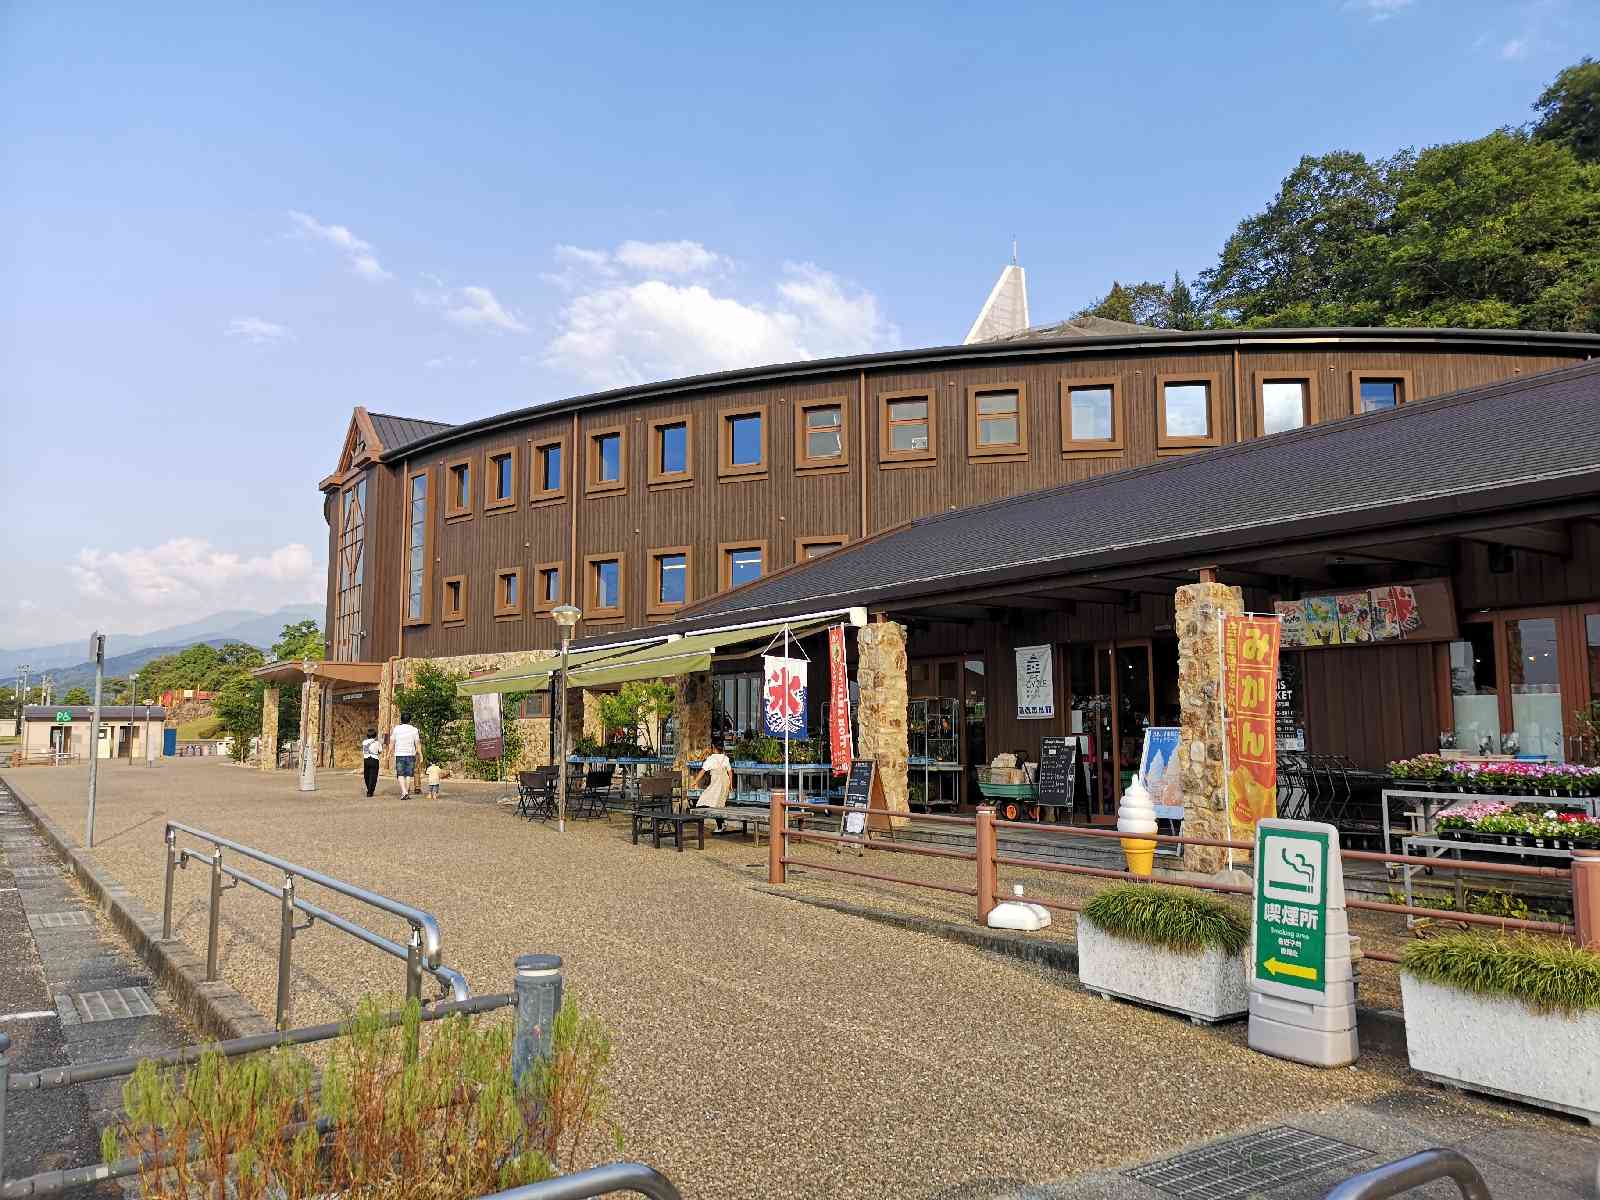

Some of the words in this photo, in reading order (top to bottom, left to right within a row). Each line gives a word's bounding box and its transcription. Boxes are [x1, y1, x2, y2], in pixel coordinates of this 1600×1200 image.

[768, 666, 802, 719] 氷
[1240, 626, 1271, 758] みかん
[1264, 903, 1319, 930] 喫煙所
